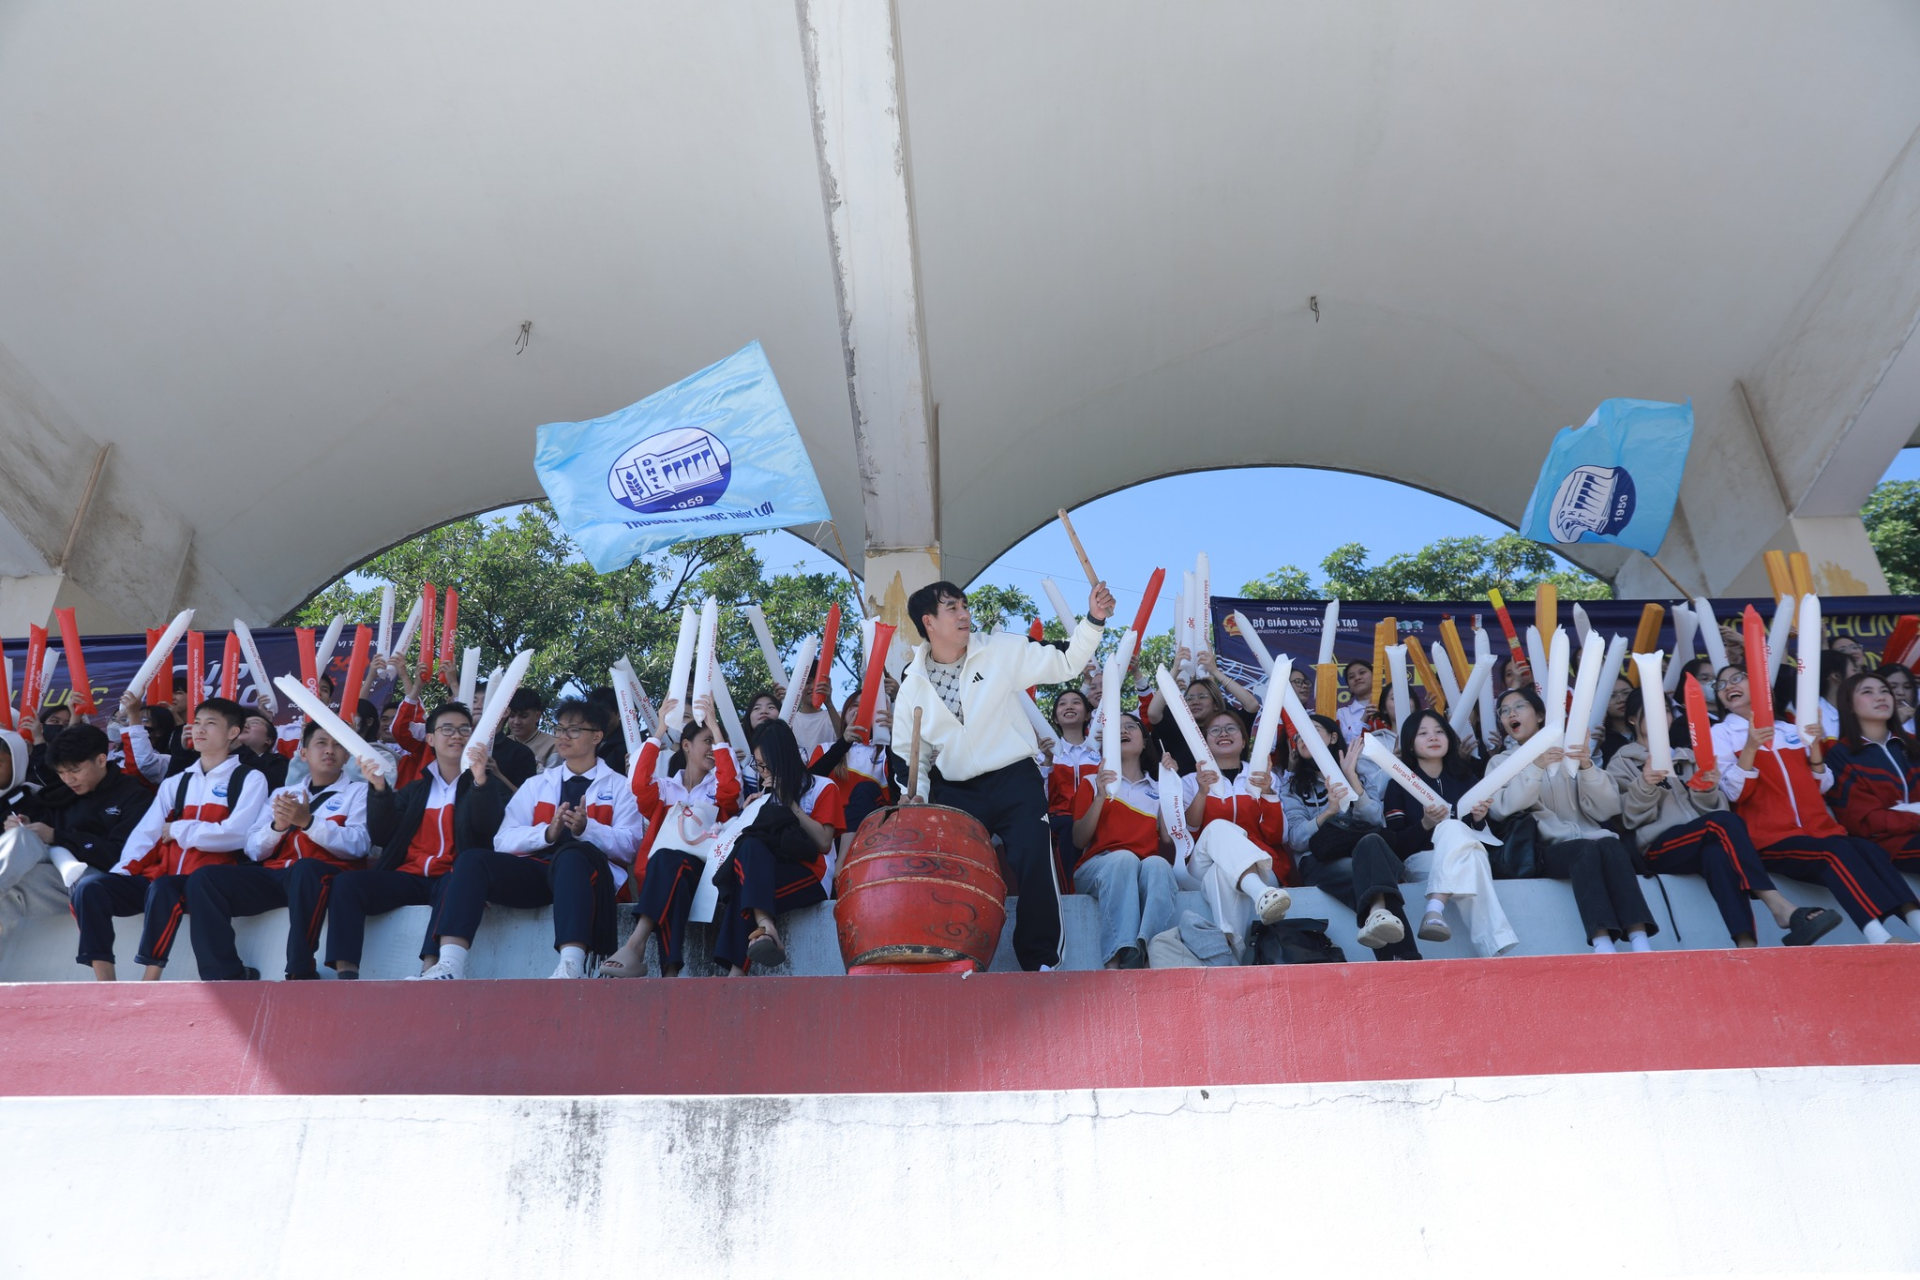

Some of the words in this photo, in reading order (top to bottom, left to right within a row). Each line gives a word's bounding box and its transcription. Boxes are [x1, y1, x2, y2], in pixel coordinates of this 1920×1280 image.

[670, 495, 704, 510] 1959
[754, 501, 775, 517] LỢI
[1252, 617, 1265, 630] BỘ
[1267, 617, 1288, 628] GIÁO
[1290, 619, 1308, 628] DỤC
[1309, 617, 1321, 627] VÀ
[1341, 618, 1358, 629] TẠO
[1287, 627, 1320, 635] EDUCATION
